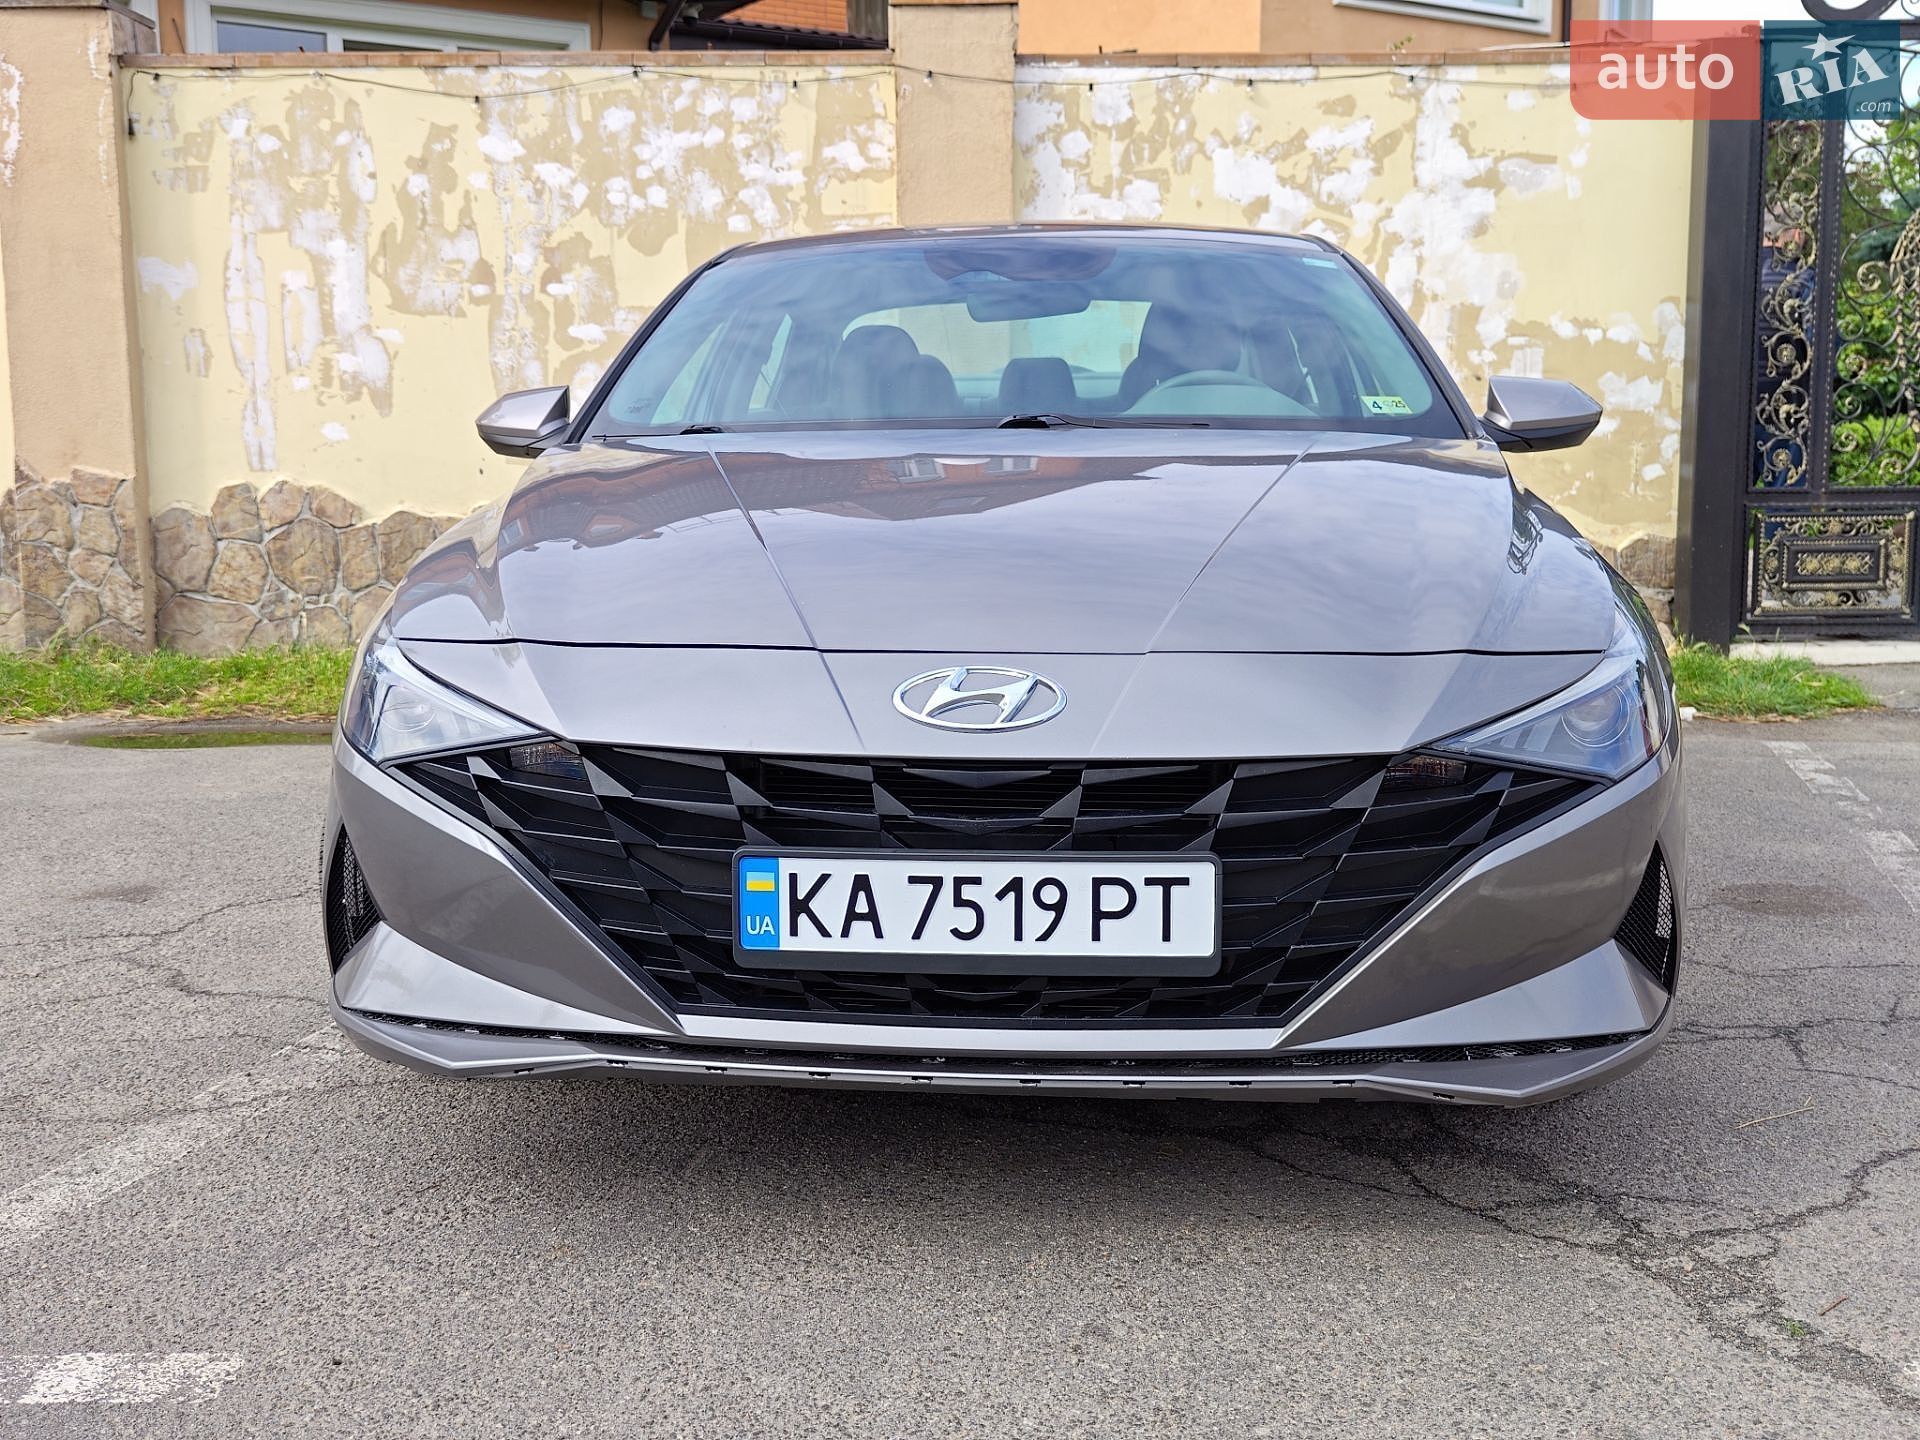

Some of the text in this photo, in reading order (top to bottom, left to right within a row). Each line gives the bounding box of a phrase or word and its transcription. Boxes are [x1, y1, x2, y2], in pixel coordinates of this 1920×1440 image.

[746, 915, 775, 936] UA
[788, 872, 1190, 943] KA 7519 PT
